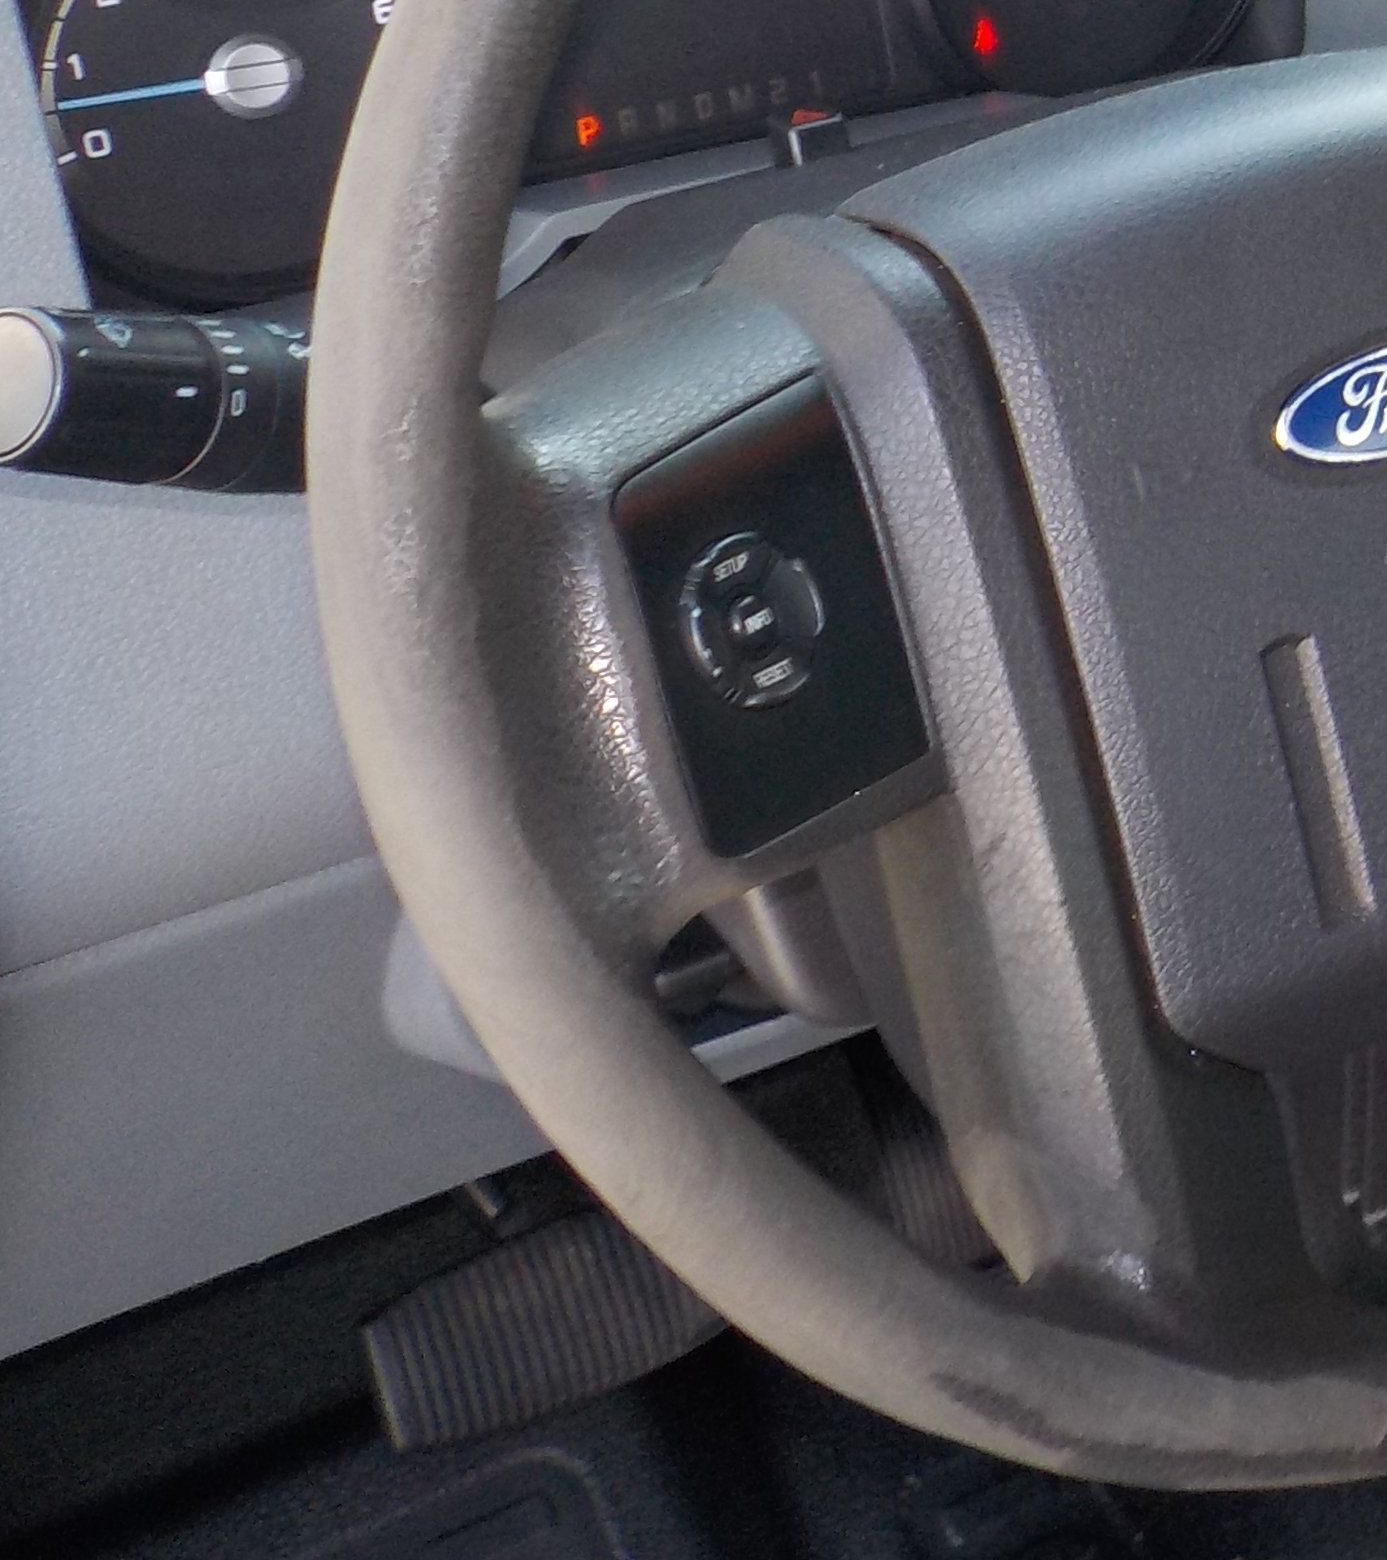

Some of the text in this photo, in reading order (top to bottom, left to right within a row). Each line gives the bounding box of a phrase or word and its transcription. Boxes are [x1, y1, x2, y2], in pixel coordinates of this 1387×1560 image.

[66, 54, 84, 81] 1
[83, 130, 112, 159] 0
[575, 114, 601, 148] P
[712, 550, 750, 582] SETUP
